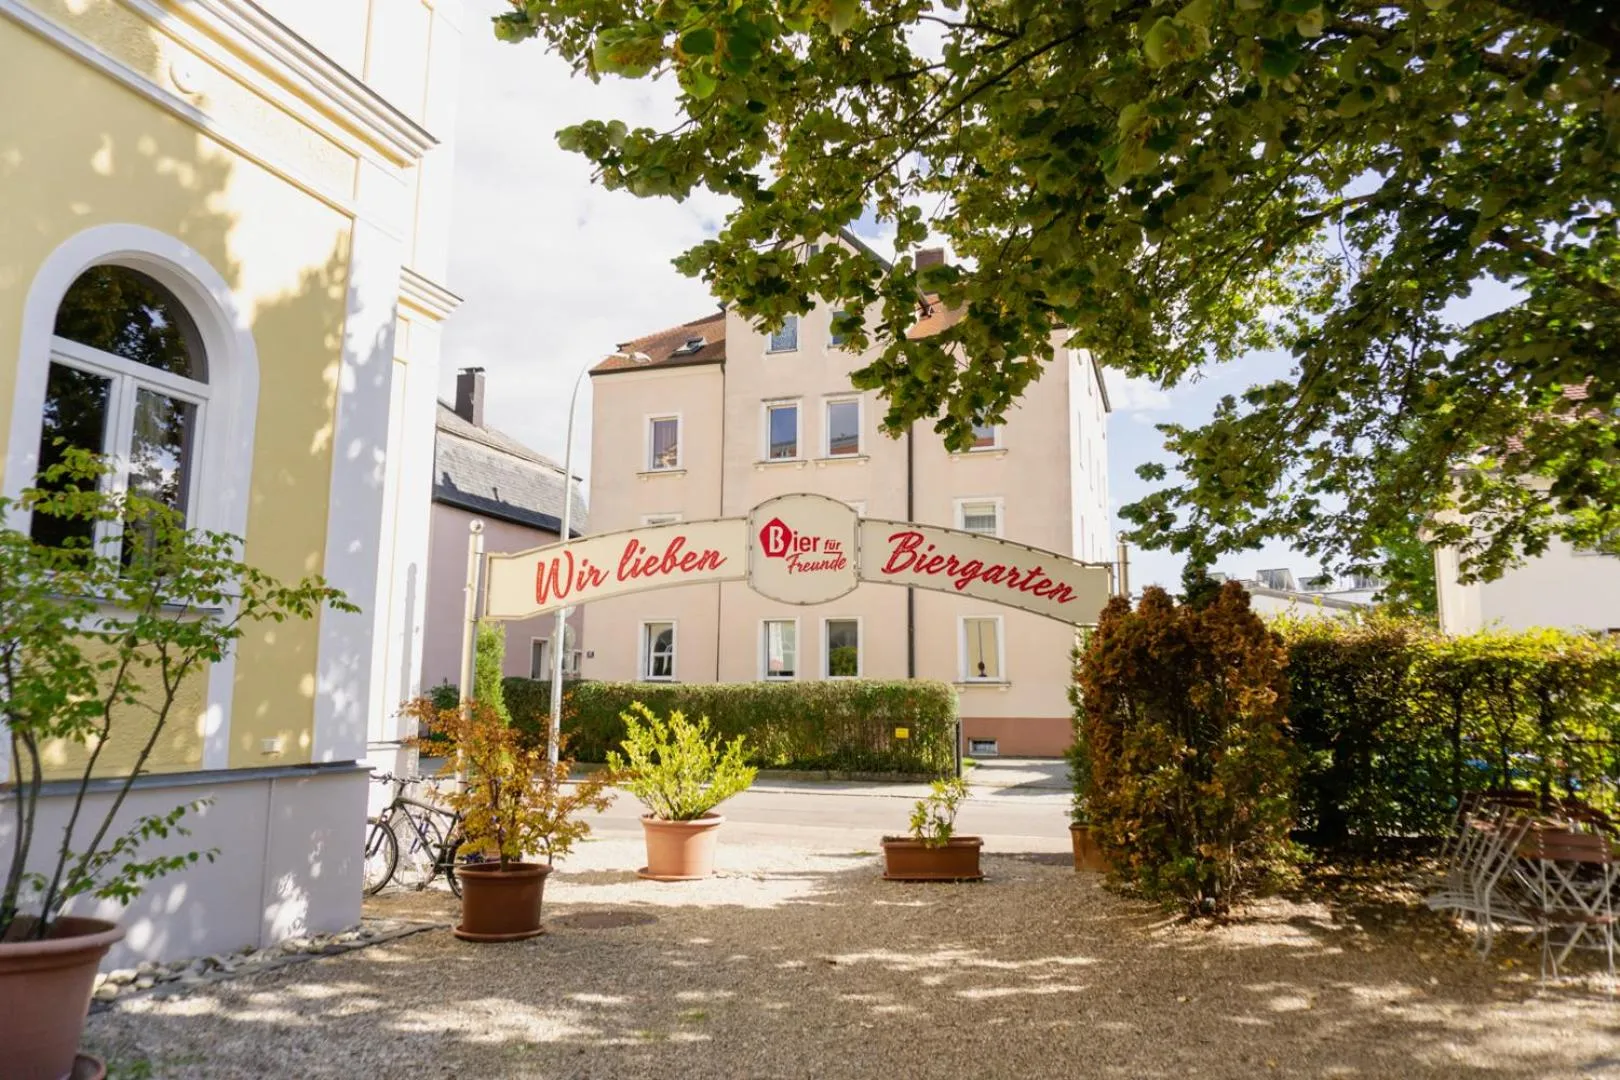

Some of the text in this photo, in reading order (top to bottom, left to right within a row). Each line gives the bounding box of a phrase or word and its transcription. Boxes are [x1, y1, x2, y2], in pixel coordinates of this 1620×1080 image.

[769, 525, 842, 553] Bier für
[785, 552, 848, 575] Freunde
[534, 535, 727, 607] Wir lieben
[880, 530, 1077, 604] Biergarten
